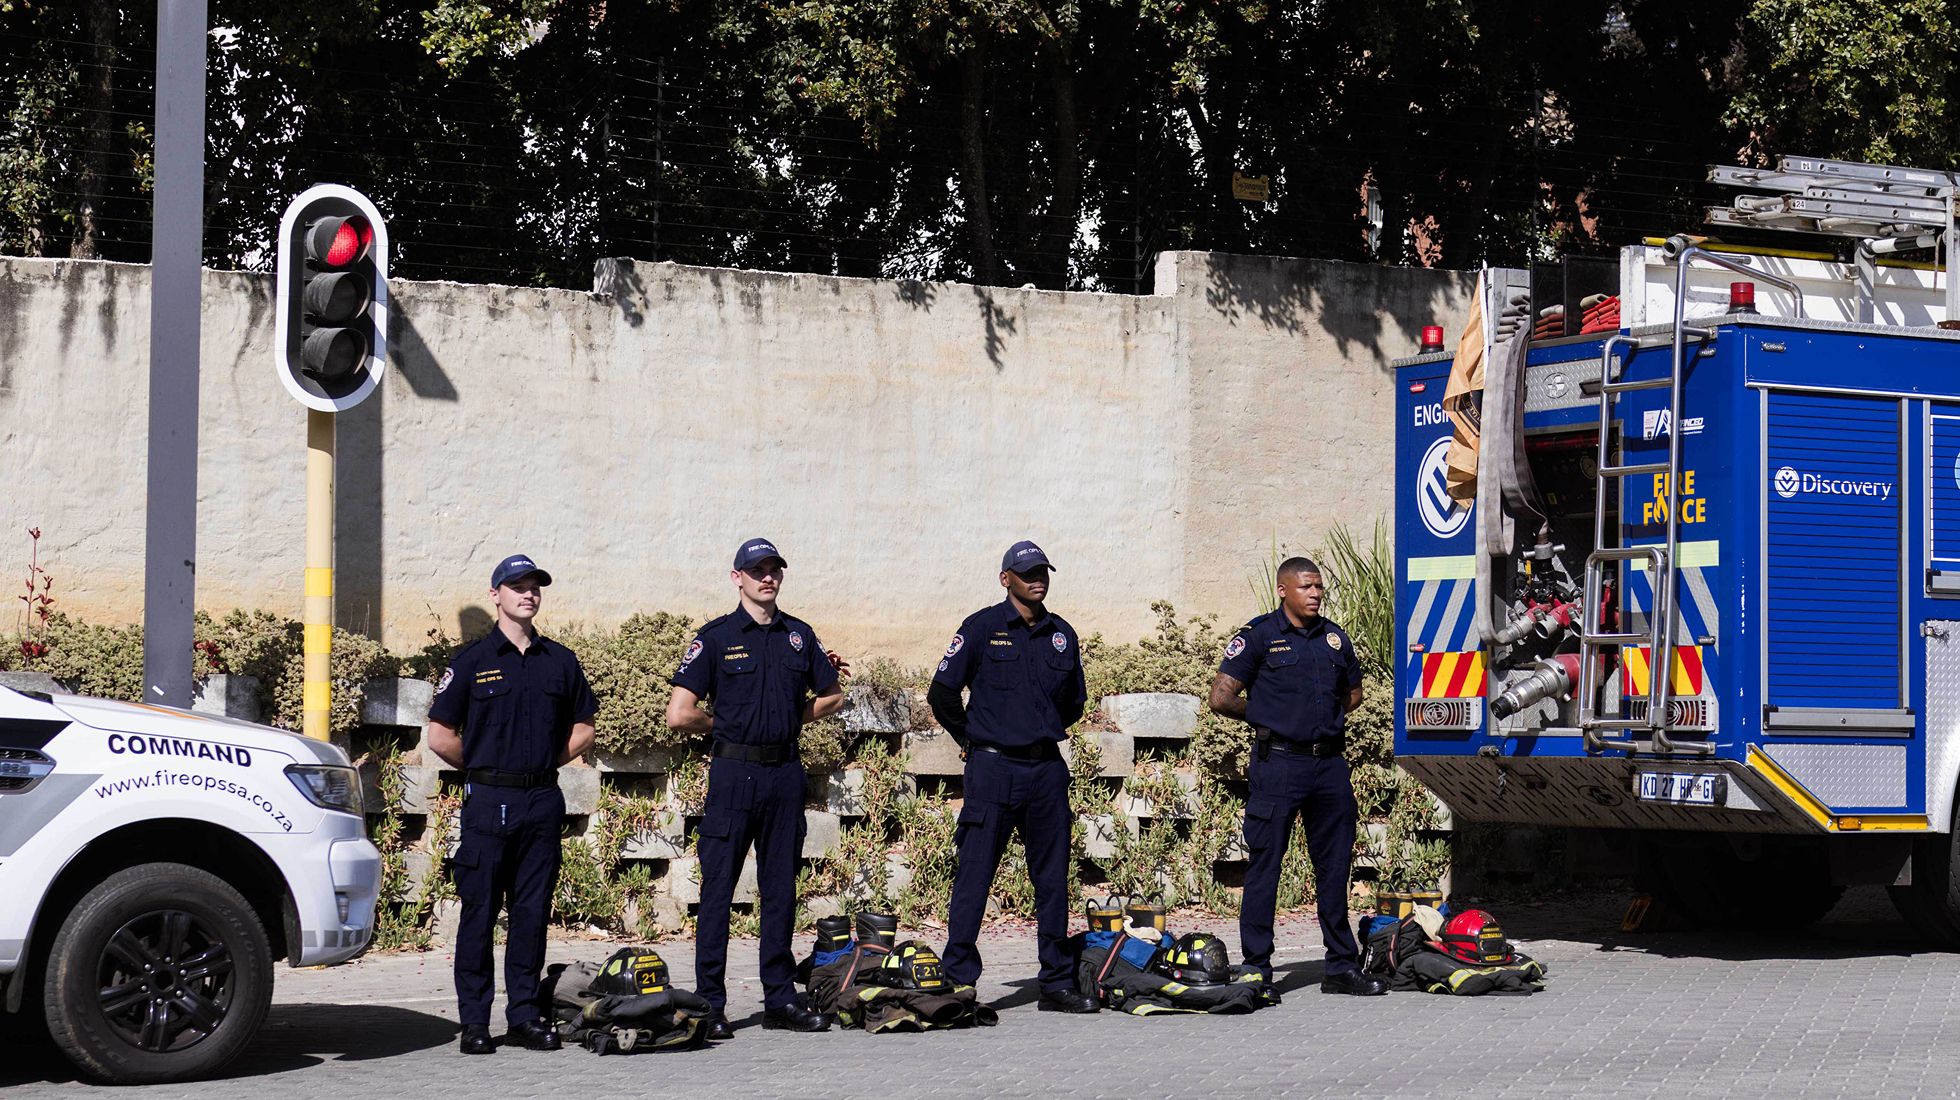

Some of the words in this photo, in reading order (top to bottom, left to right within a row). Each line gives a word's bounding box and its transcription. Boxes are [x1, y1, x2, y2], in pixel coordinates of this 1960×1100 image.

[1796, 200, 1805, 208] 24
[1414, 402, 1449, 427] ENGI
[1803, 473, 1892, 501] Discovery
[107, 733, 252, 768] COMMAND
[1643, 776, 1657, 797] KD
[1662, 777, 1675, 798] 27
[1680, 778, 1693, 799] HR
[94, 769, 294, 833] www.fireopssa.co.za
[642, 972, 656, 985] 21
[924, 966, 937, 977] 21
